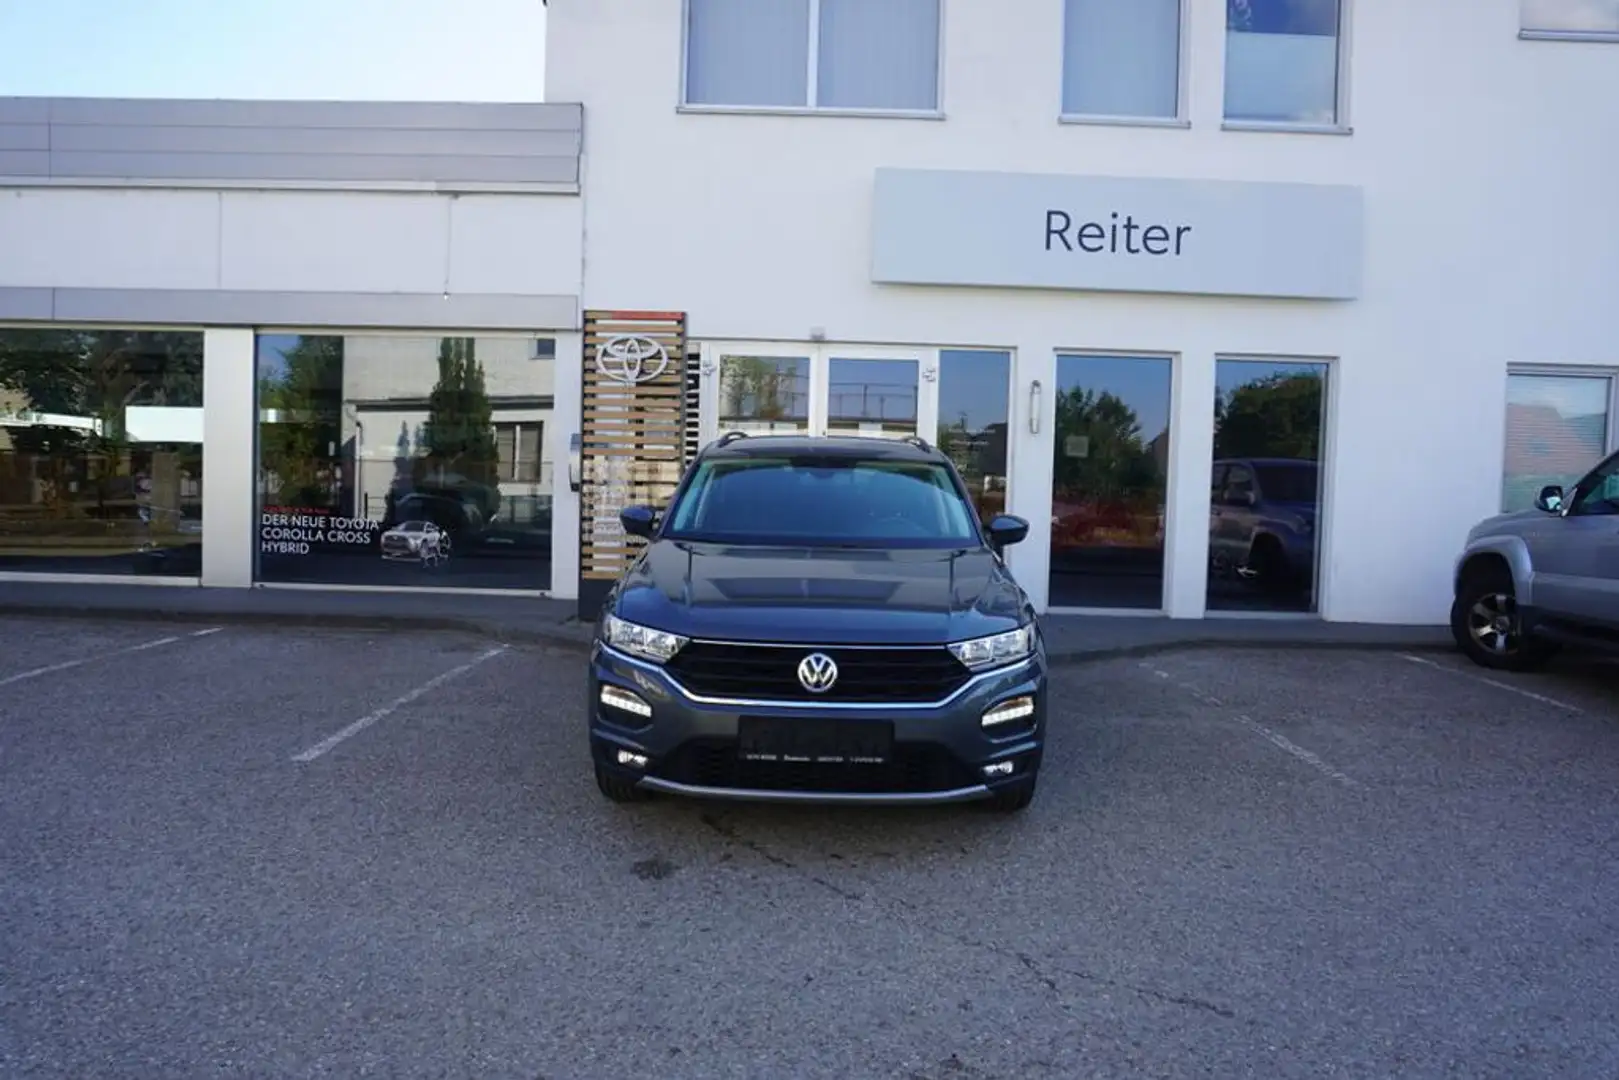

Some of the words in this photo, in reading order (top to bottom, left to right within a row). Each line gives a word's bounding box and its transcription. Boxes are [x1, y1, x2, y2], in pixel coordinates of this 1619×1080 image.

[1045, 210, 1192, 256] Reiter
[262, 514, 288, 526] DER
[292, 515, 326, 528] NEUE
[329, 517, 380, 531] TOYOTA
[261, 527, 324, 541] COROLLA
[327, 530, 371, 544] CROSS
[261, 541, 310, 554] HYBRID
